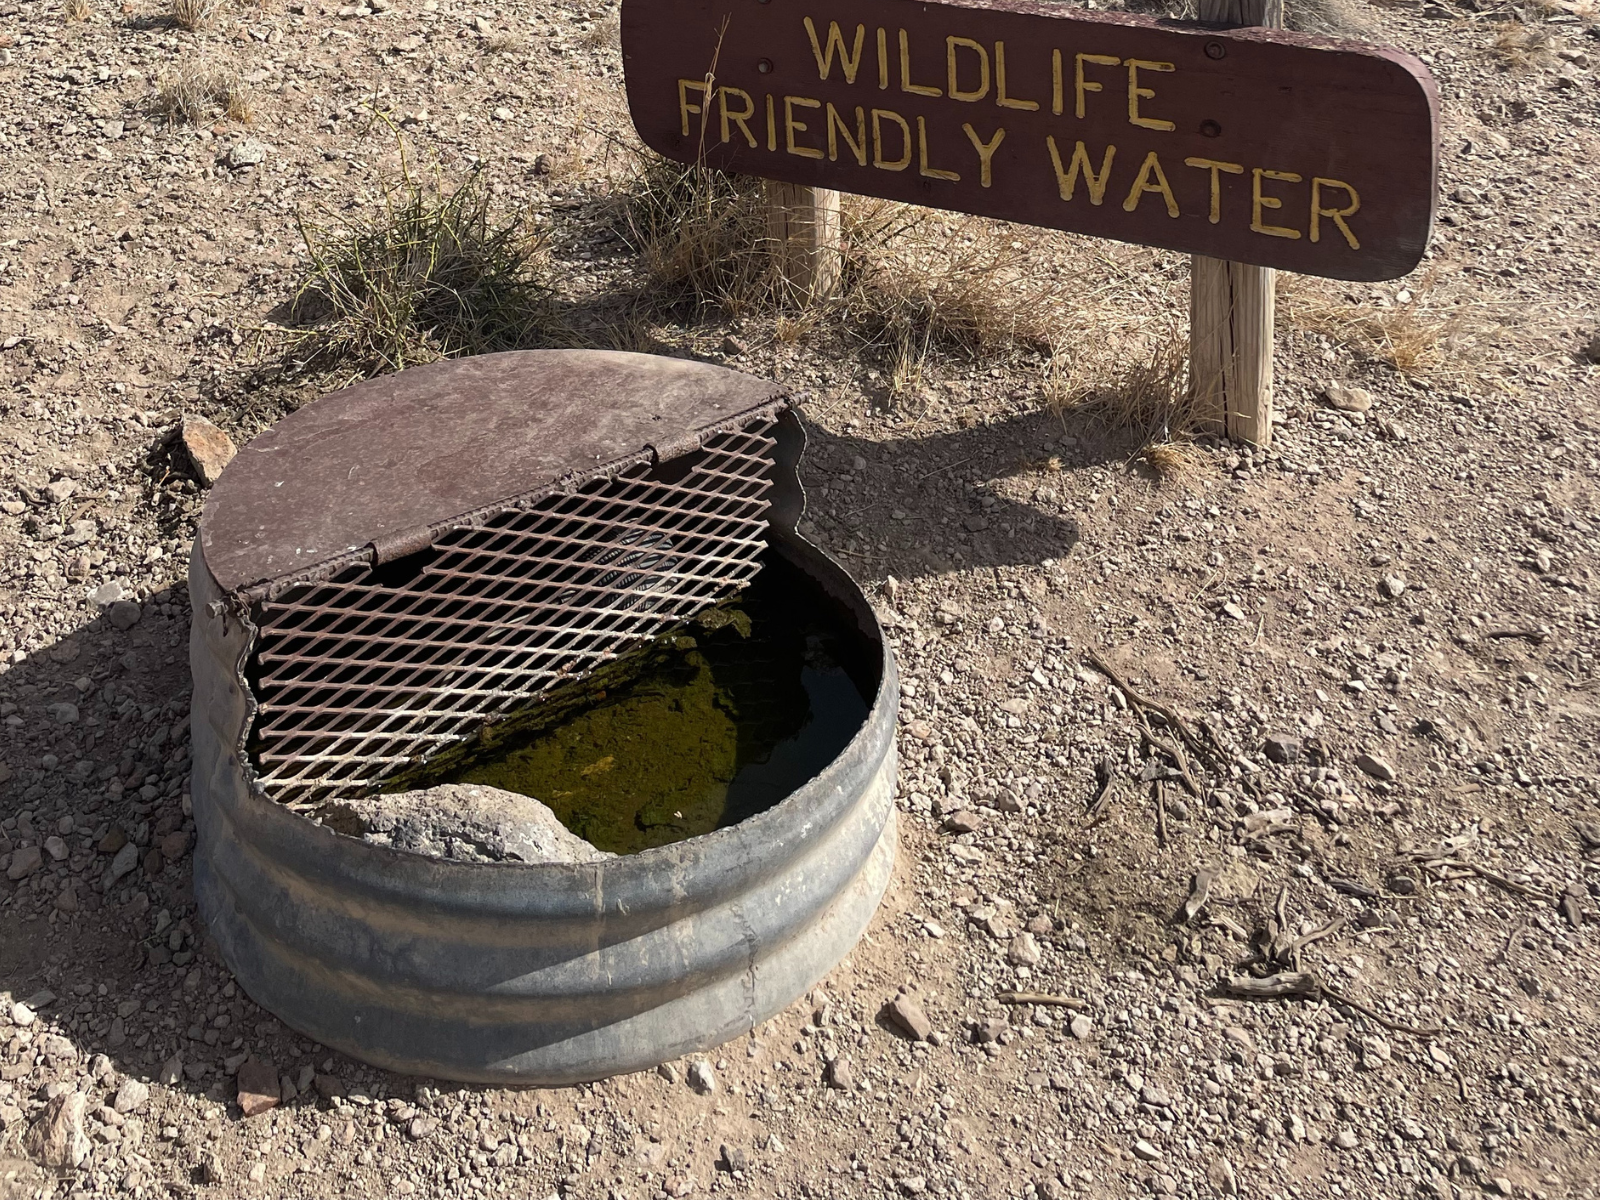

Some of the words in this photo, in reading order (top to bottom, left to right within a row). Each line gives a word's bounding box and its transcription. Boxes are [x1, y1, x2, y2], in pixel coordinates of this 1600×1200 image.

[803, 15, 1176, 132] WILDLIFE
[677, 78, 1006, 188] FRIENDLY
[1046, 135, 1361, 250] WATER
